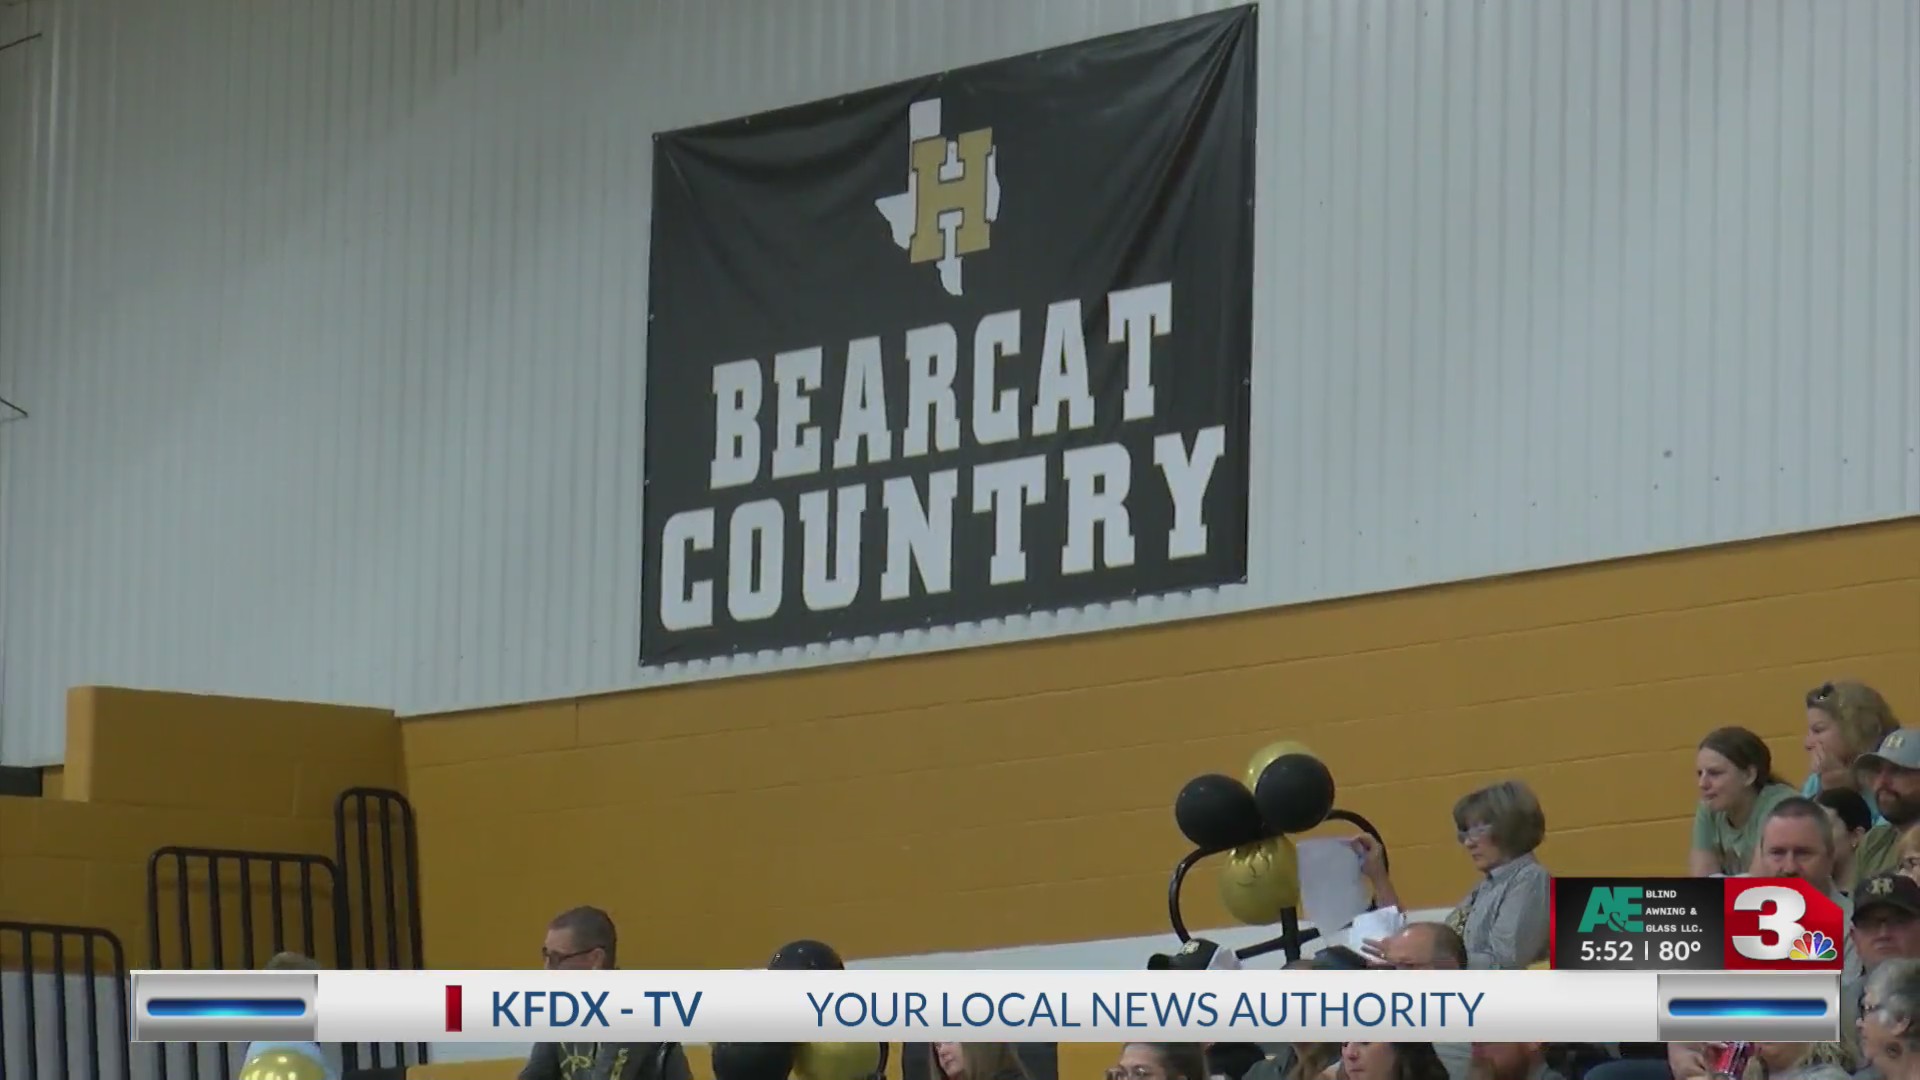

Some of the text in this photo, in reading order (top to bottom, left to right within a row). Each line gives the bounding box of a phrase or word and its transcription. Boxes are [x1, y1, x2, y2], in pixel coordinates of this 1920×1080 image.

[910, 127, 994, 264] H
[710, 282, 1172, 490] BEARCAT
[659, 425, 1225, 632] COUNTRY
